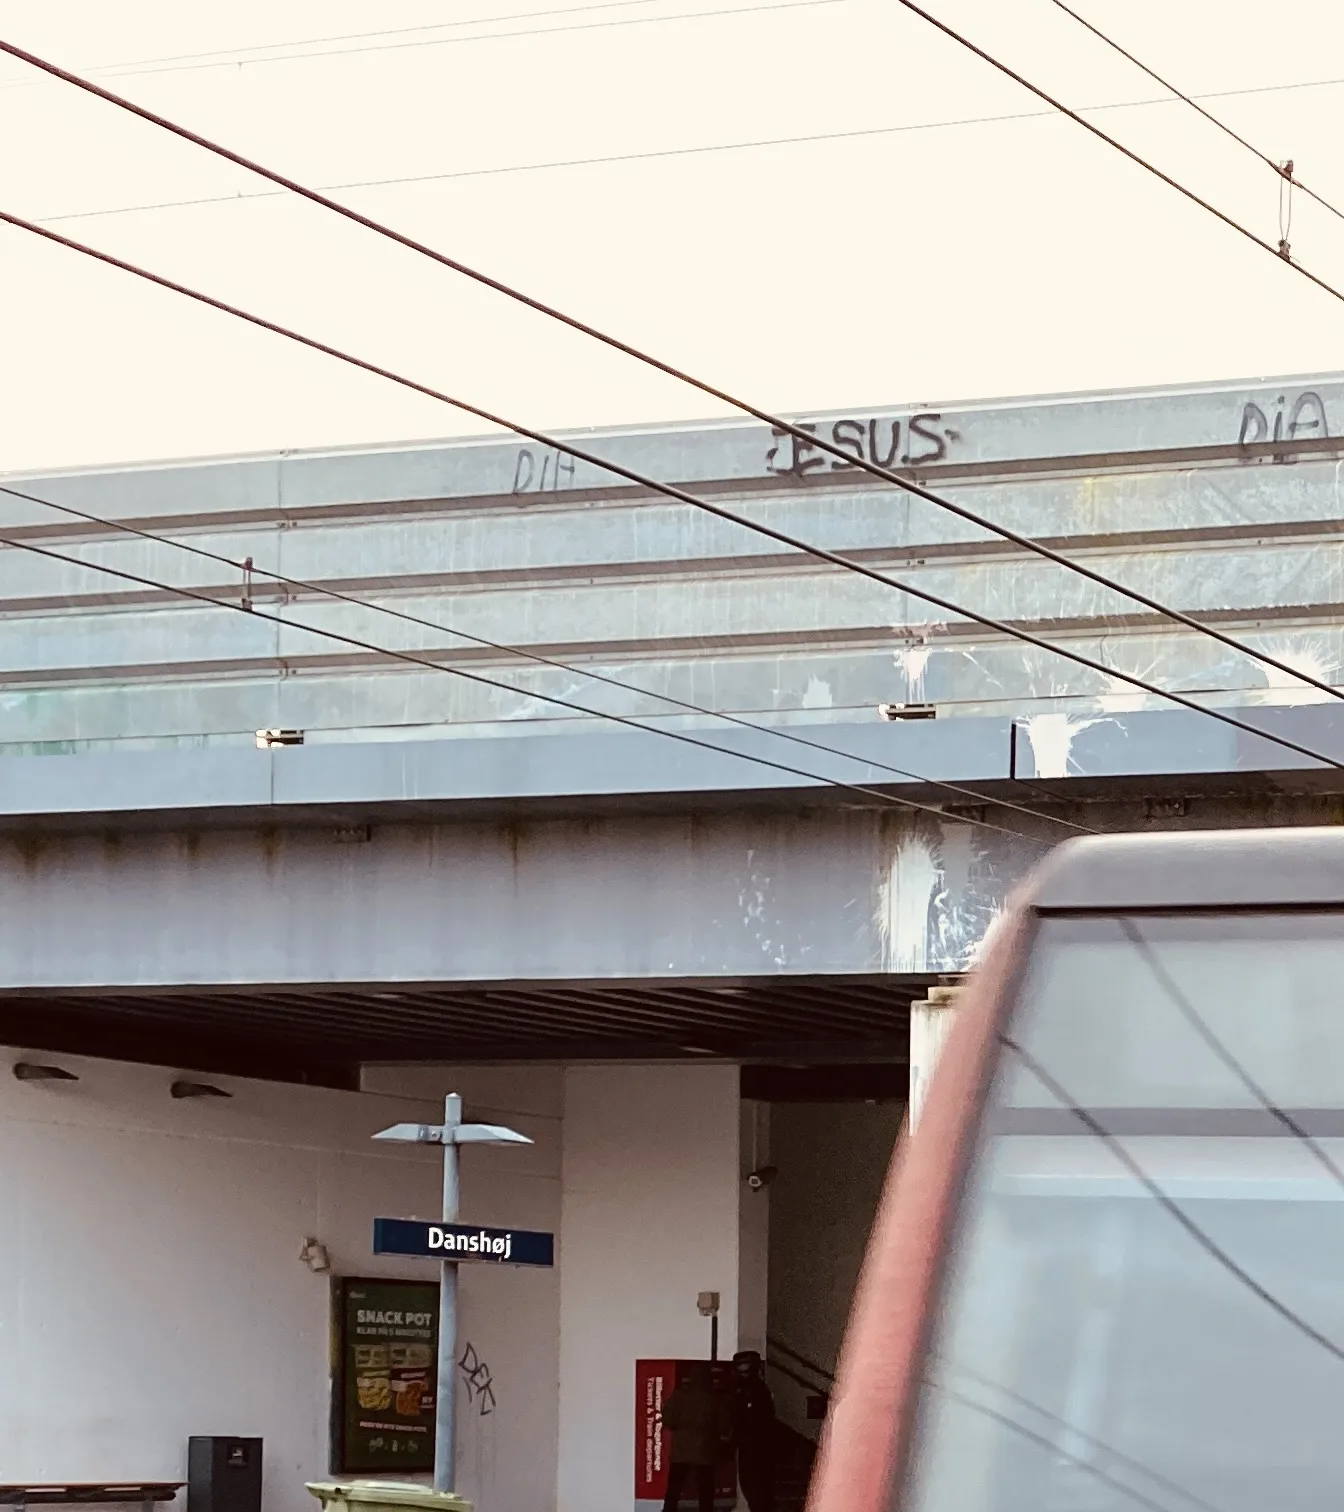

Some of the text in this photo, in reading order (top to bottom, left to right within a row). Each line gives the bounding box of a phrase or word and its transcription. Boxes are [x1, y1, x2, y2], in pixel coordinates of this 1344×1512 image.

[428, 1226, 512, 1259] Danshøj
[356, 1309, 432, 1328] SNACK POT
